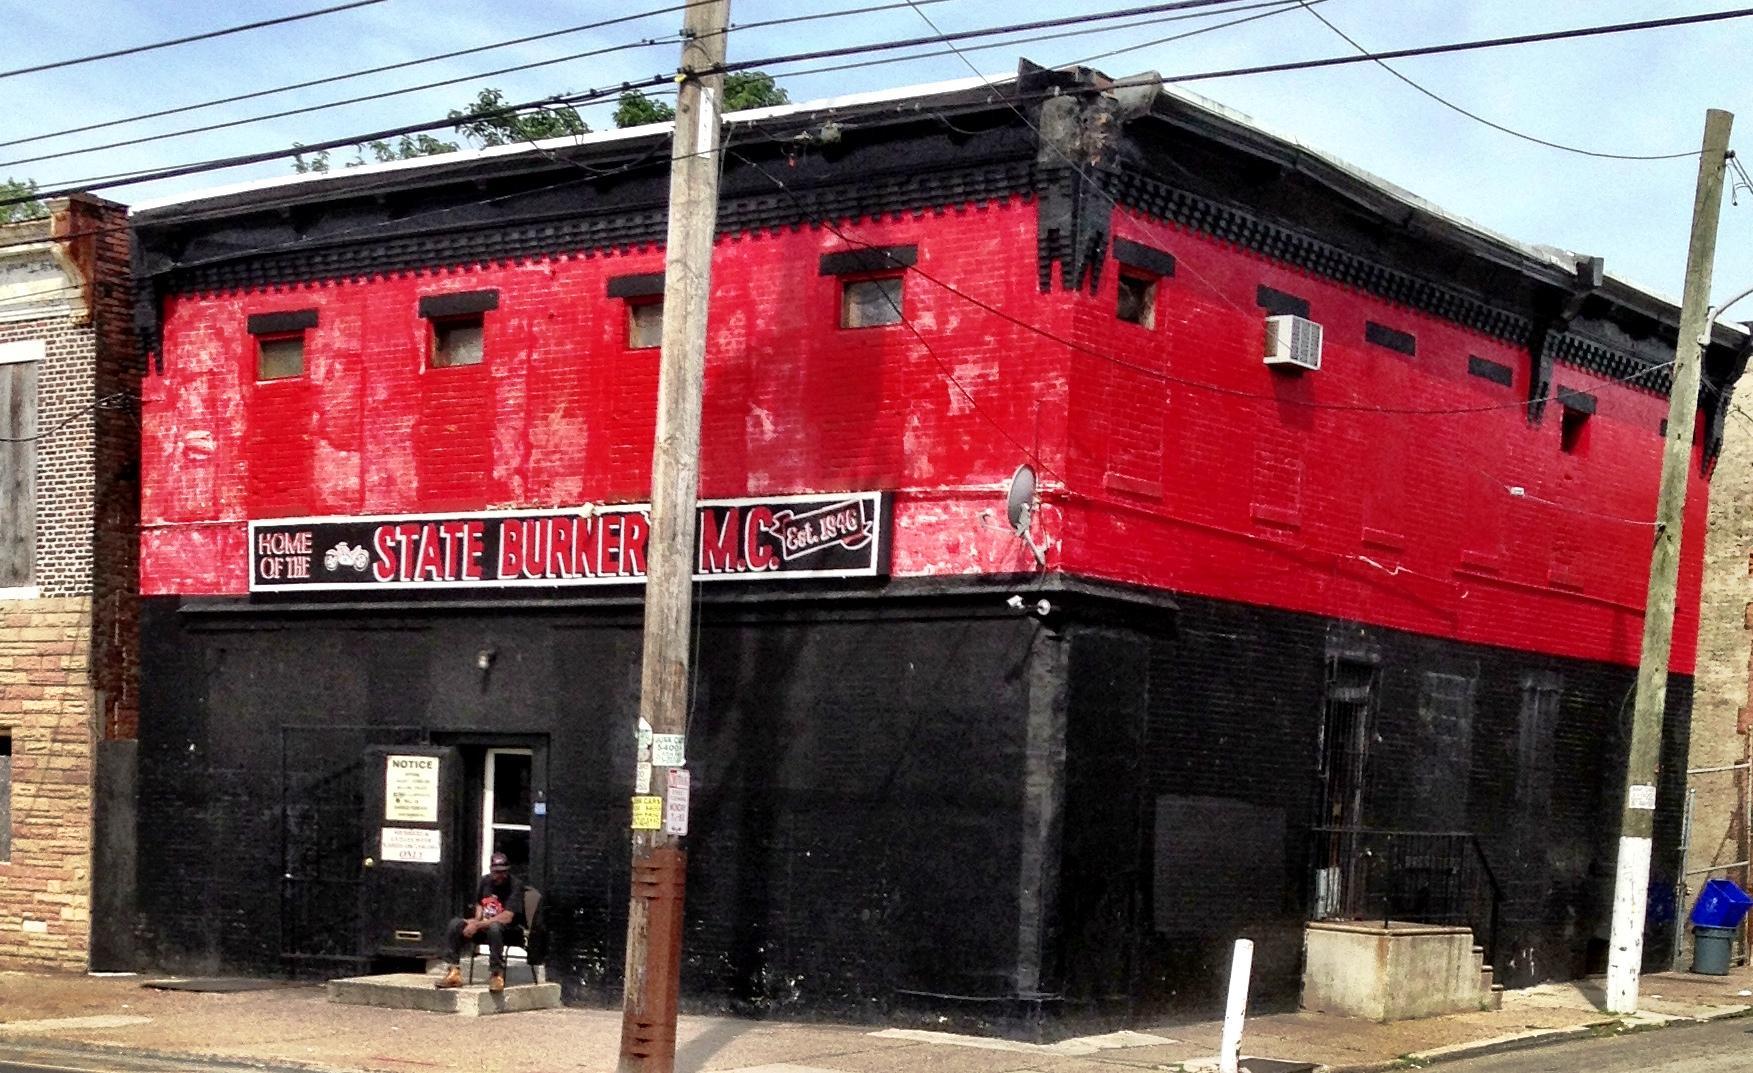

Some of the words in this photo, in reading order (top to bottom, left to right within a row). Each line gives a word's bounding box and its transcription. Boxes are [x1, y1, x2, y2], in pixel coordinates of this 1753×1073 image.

[786, 523, 819, 550] Est.
[819, 509, 857, 541] 1946
[258, 532, 313, 555] HOME
[373, 521, 484, 582] STATE
[497, 511, 651, 579] BURNER
[698, 506, 780, 574] M.C.
[260, 557, 284, 579] OF
[285, 556, 311, 578] THE
[392, 759, 433, 770] NOTICE
